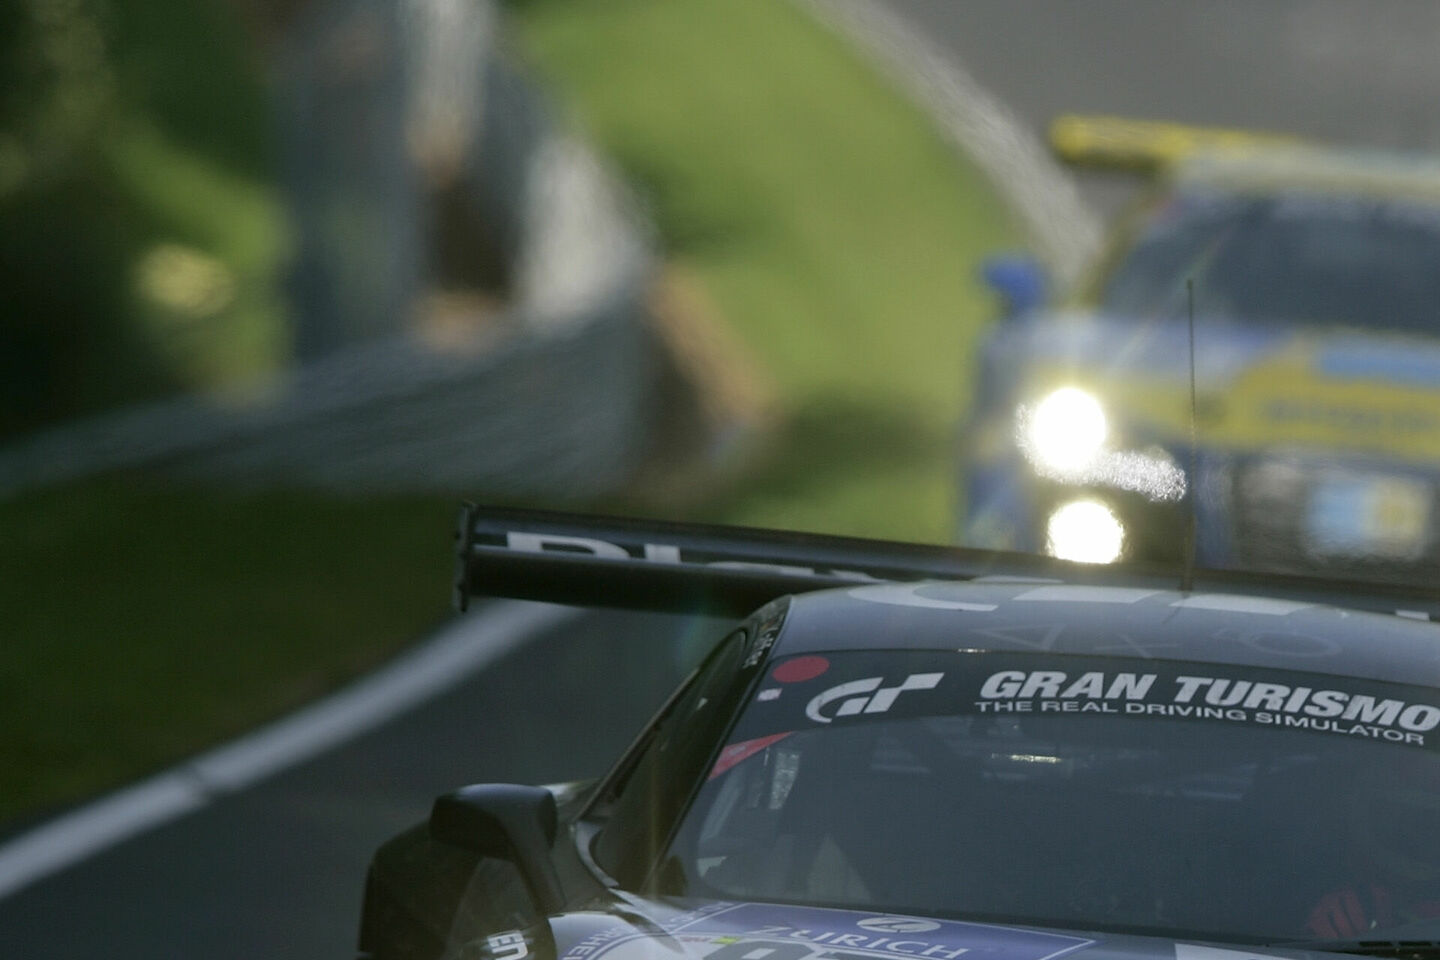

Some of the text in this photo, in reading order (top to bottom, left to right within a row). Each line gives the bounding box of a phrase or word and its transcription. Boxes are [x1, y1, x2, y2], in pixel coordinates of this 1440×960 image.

[980, 671, 1157, 700] GRAN
[974, 700, 1425, 746] THE REAL DRIVING SIMULATOR
[746, 924, 970, 960] ZURICH
